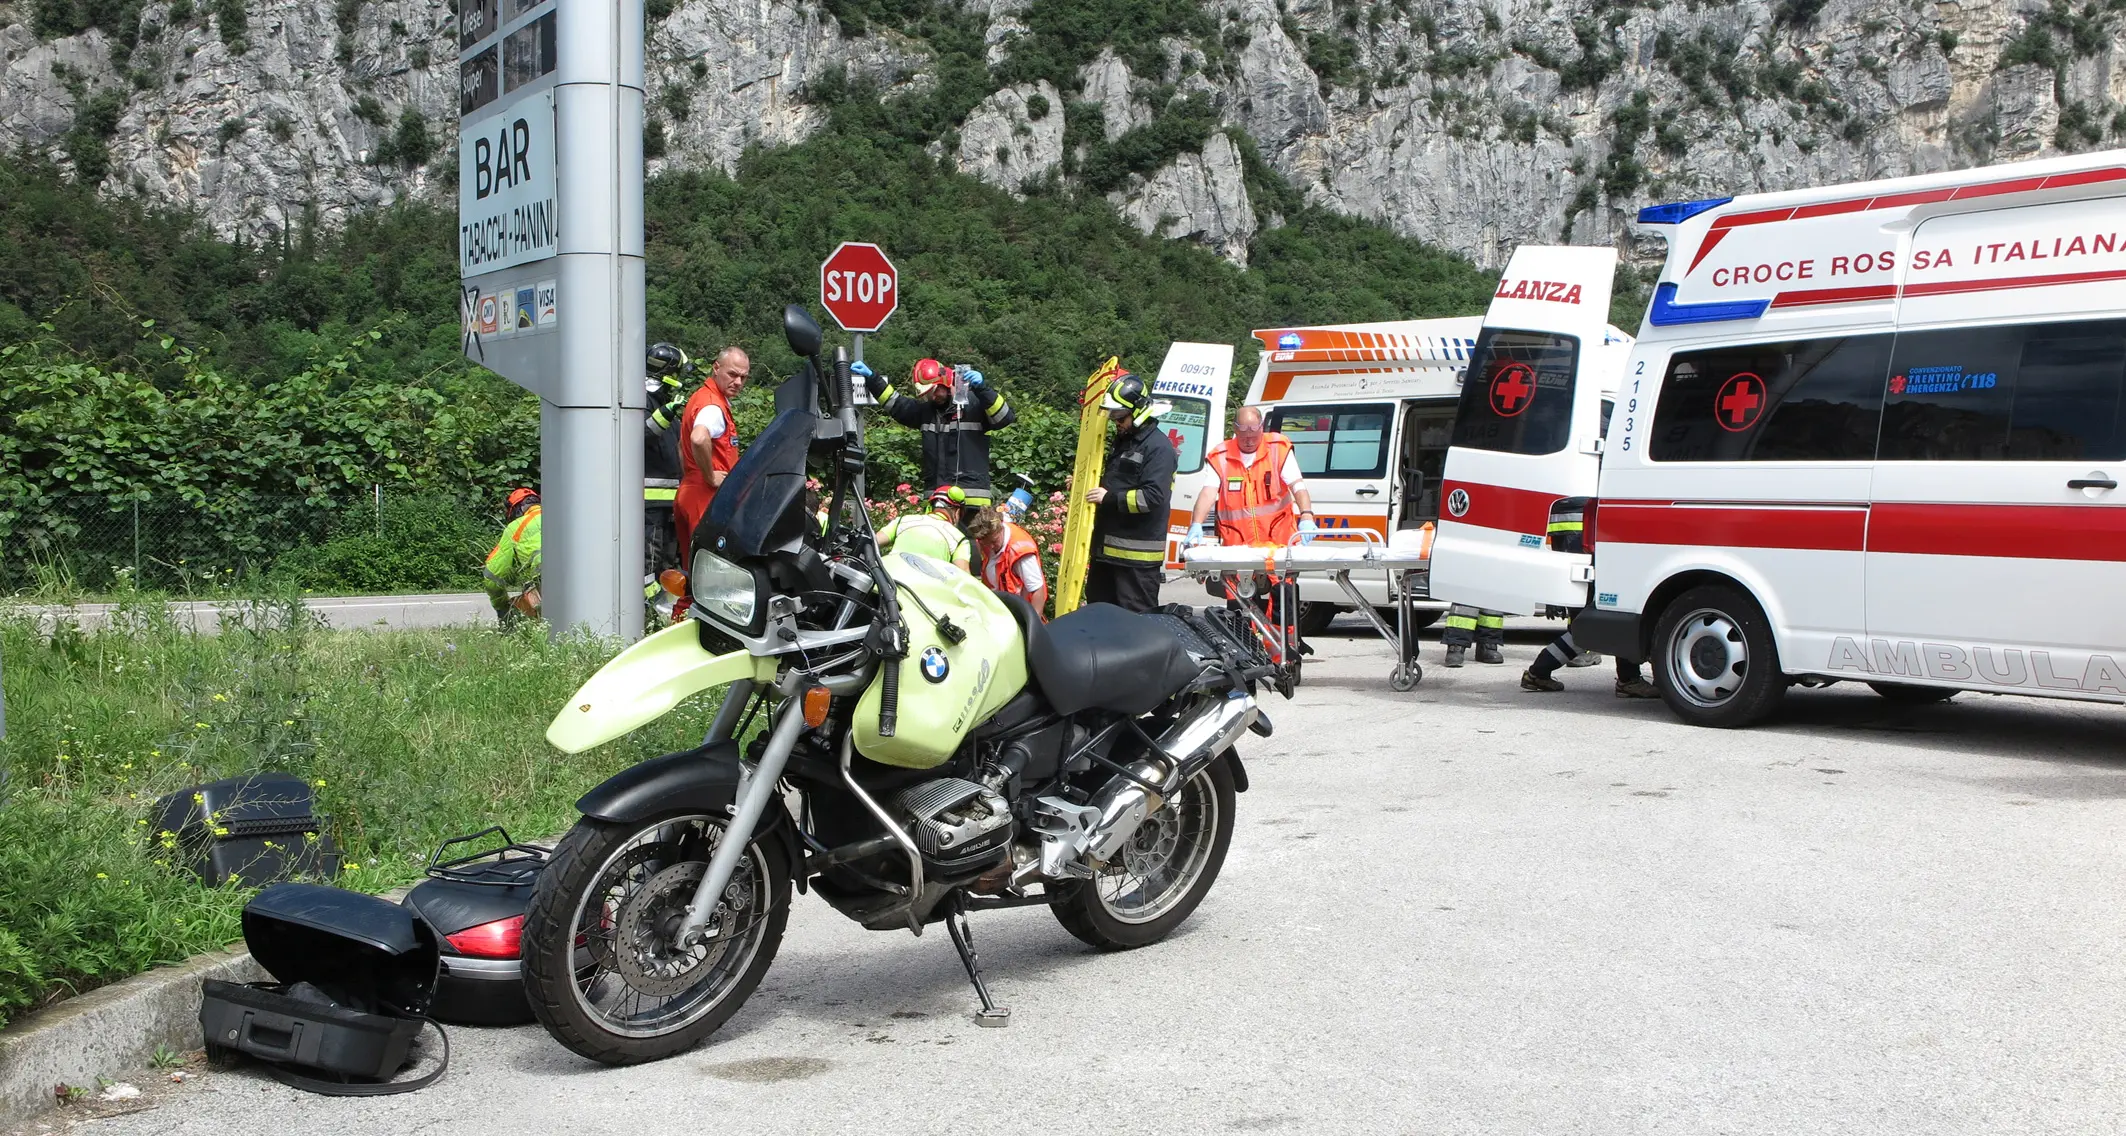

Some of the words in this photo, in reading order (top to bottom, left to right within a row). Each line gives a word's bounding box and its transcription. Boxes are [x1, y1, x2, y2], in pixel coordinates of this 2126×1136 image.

[463, 69, 484, 97] super
[475, 118, 531, 200] BAR
[463, 213, 507, 267] TABACCHI
[514, 198, 553, 254] PANINI
[1712, 259, 1815, 287] CROCE
[1830, 248, 1954, 277] ROSSA
[539, 288, 555, 308] VISA
[826, 269, 893, 304] STOP
[1495, 279, 1582, 305] LANZA
[1180, 363, 1215, 376] 009/31
[1908, 373, 1960, 384] TRENTINO
[1909, 365, 1962, 375] CONVENZIONATO
[1970, 372, 1997, 389] 118
[1154, 380, 1213, 397] EMERGENZA
[1906, 383, 1959, 394] EMERGENZA
[1827, 636, 2126, 693] AMBULA
